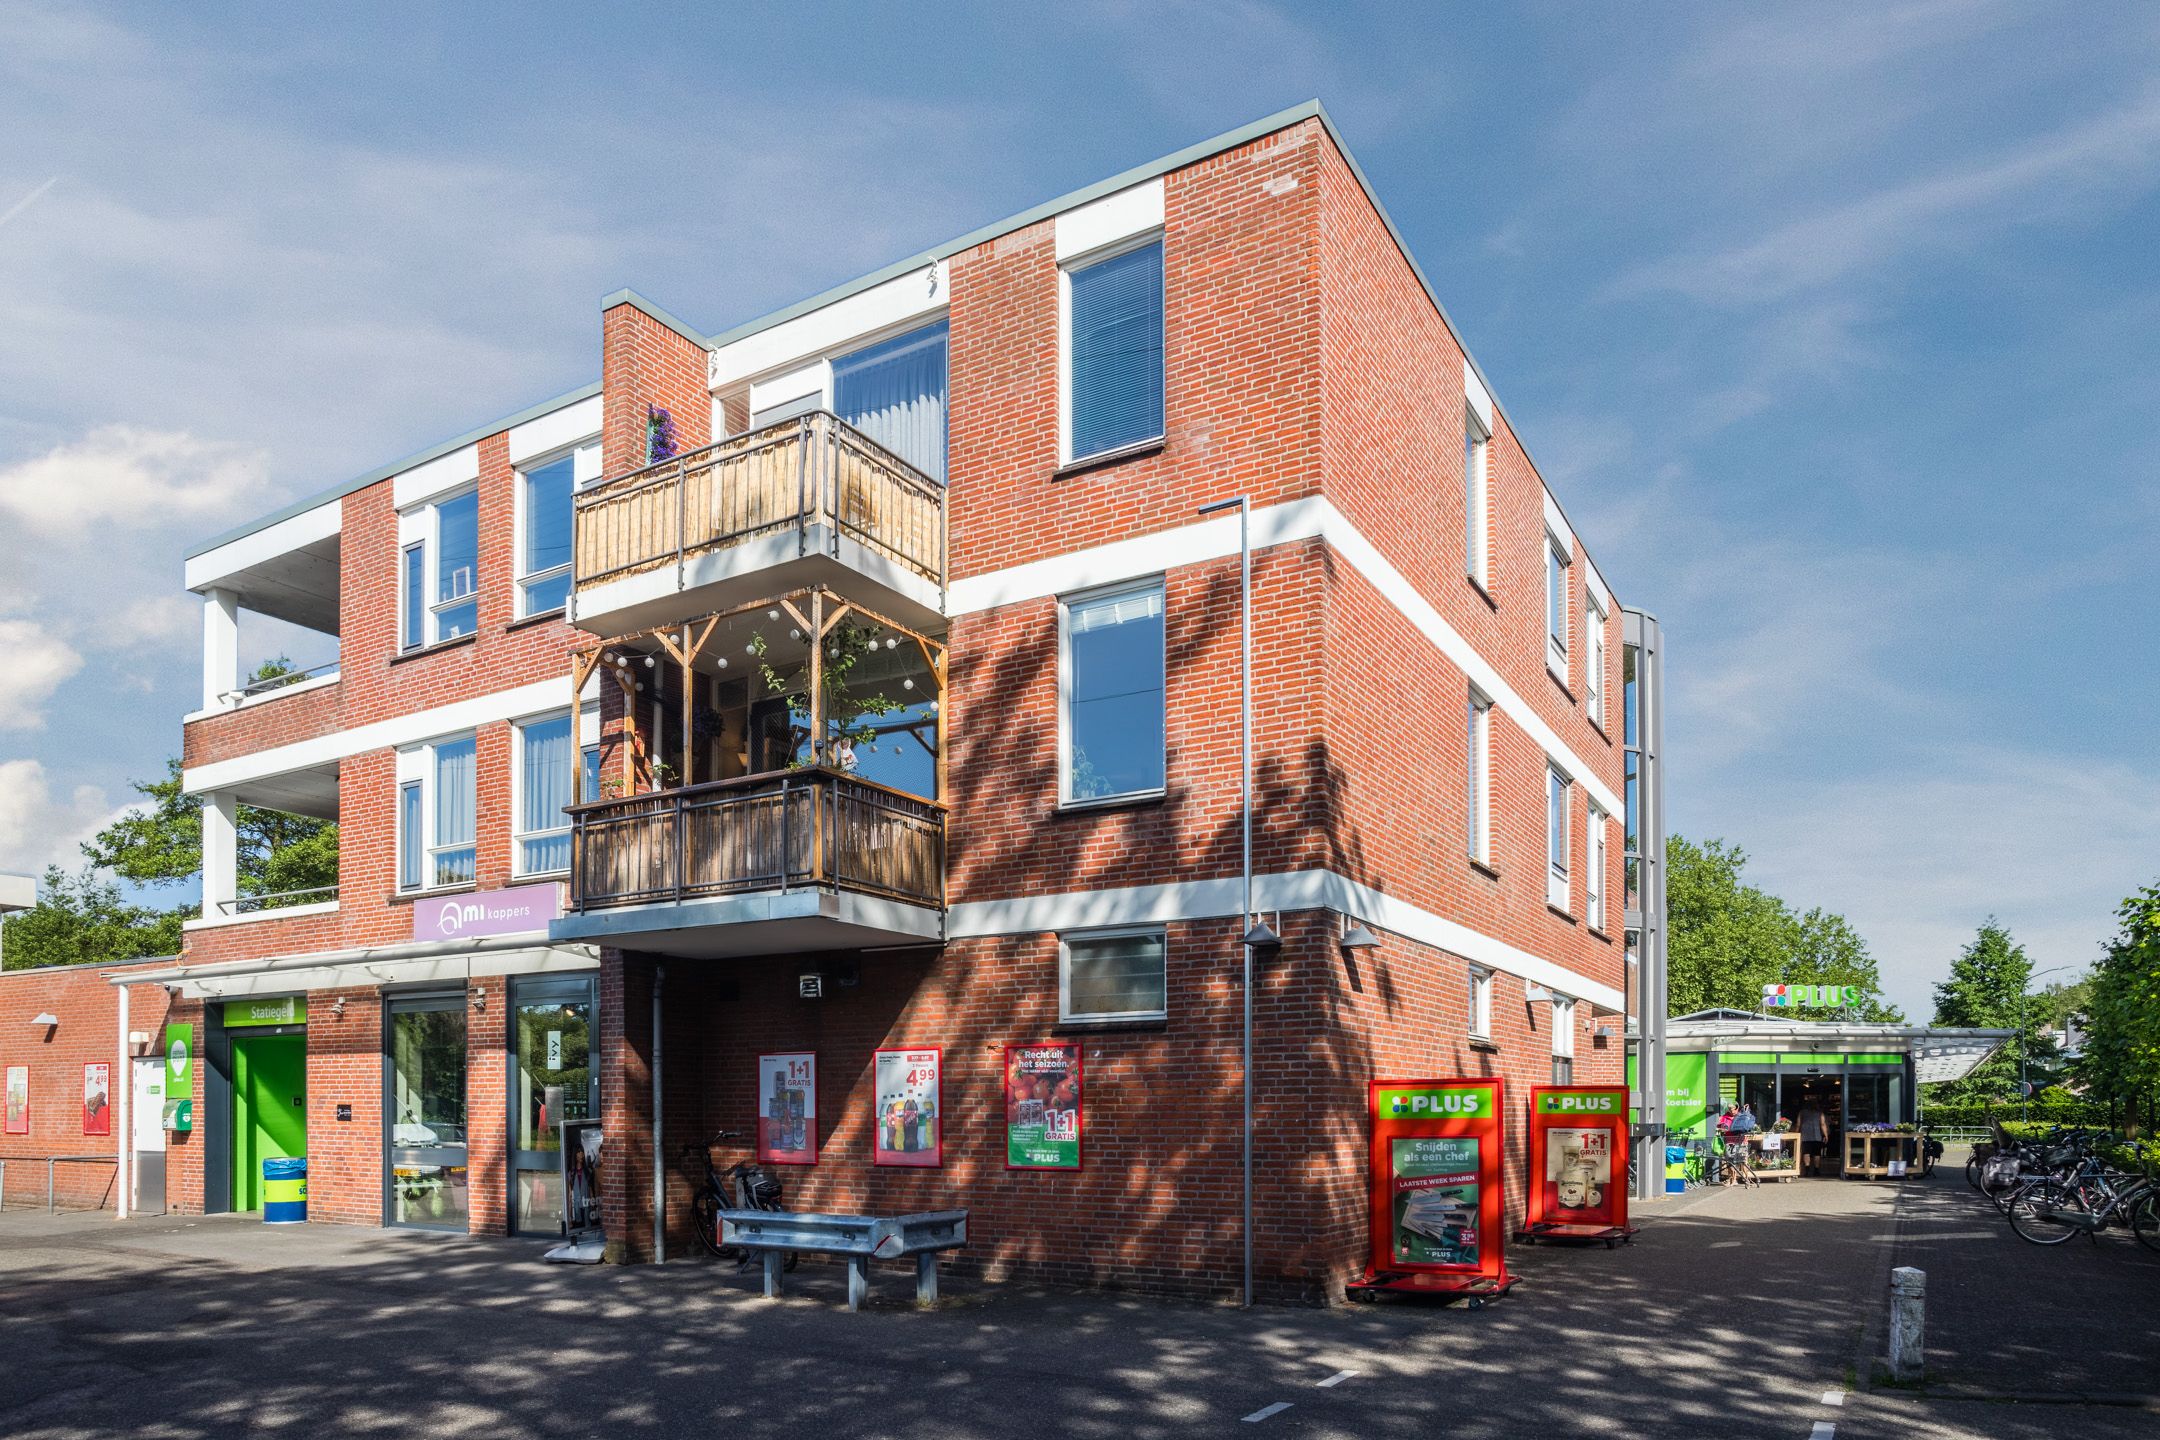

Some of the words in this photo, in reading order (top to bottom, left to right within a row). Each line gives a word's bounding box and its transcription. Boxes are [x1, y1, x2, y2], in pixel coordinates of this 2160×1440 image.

[488, 906, 530, 920] kappers
[1791, 985, 1860, 1008] PLUS
[549, 1040, 559, 1060] ivy
[1025, 1050, 1050, 1058] Recht
[1052, 1050, 1063, 1058] uit
[788, 1060, 810, 1078] 1+1
[1018, 1060, 1033, 1068] het
[788, 1079, 811, 1087] GRATIS
[906, 1069, 935, 1086] 4.99
[1412, 1095, 1478, 1113] PLUS
[1562, 1097, 1611, 1110] PLUS
[1046, 1110, 1074, 1132] 1+1
[1045, 1132, 1075, 1140] GRATIS
[1581, 1133, 1606, 1149] 1+1
[1416, 1142, 1456, 1152] Snijden
[1034, 1153, 1060, 1162] PLUS
[1404, 1153, 1419, 1162] als
[1445, 1152, 1469, 1161] chef
[1399, 1180, 1428, 1188] LAATSTE
[1429, 1177, 1448, 1185] WEEK
[1449, 1175, 1475, 1183] SPAREN
